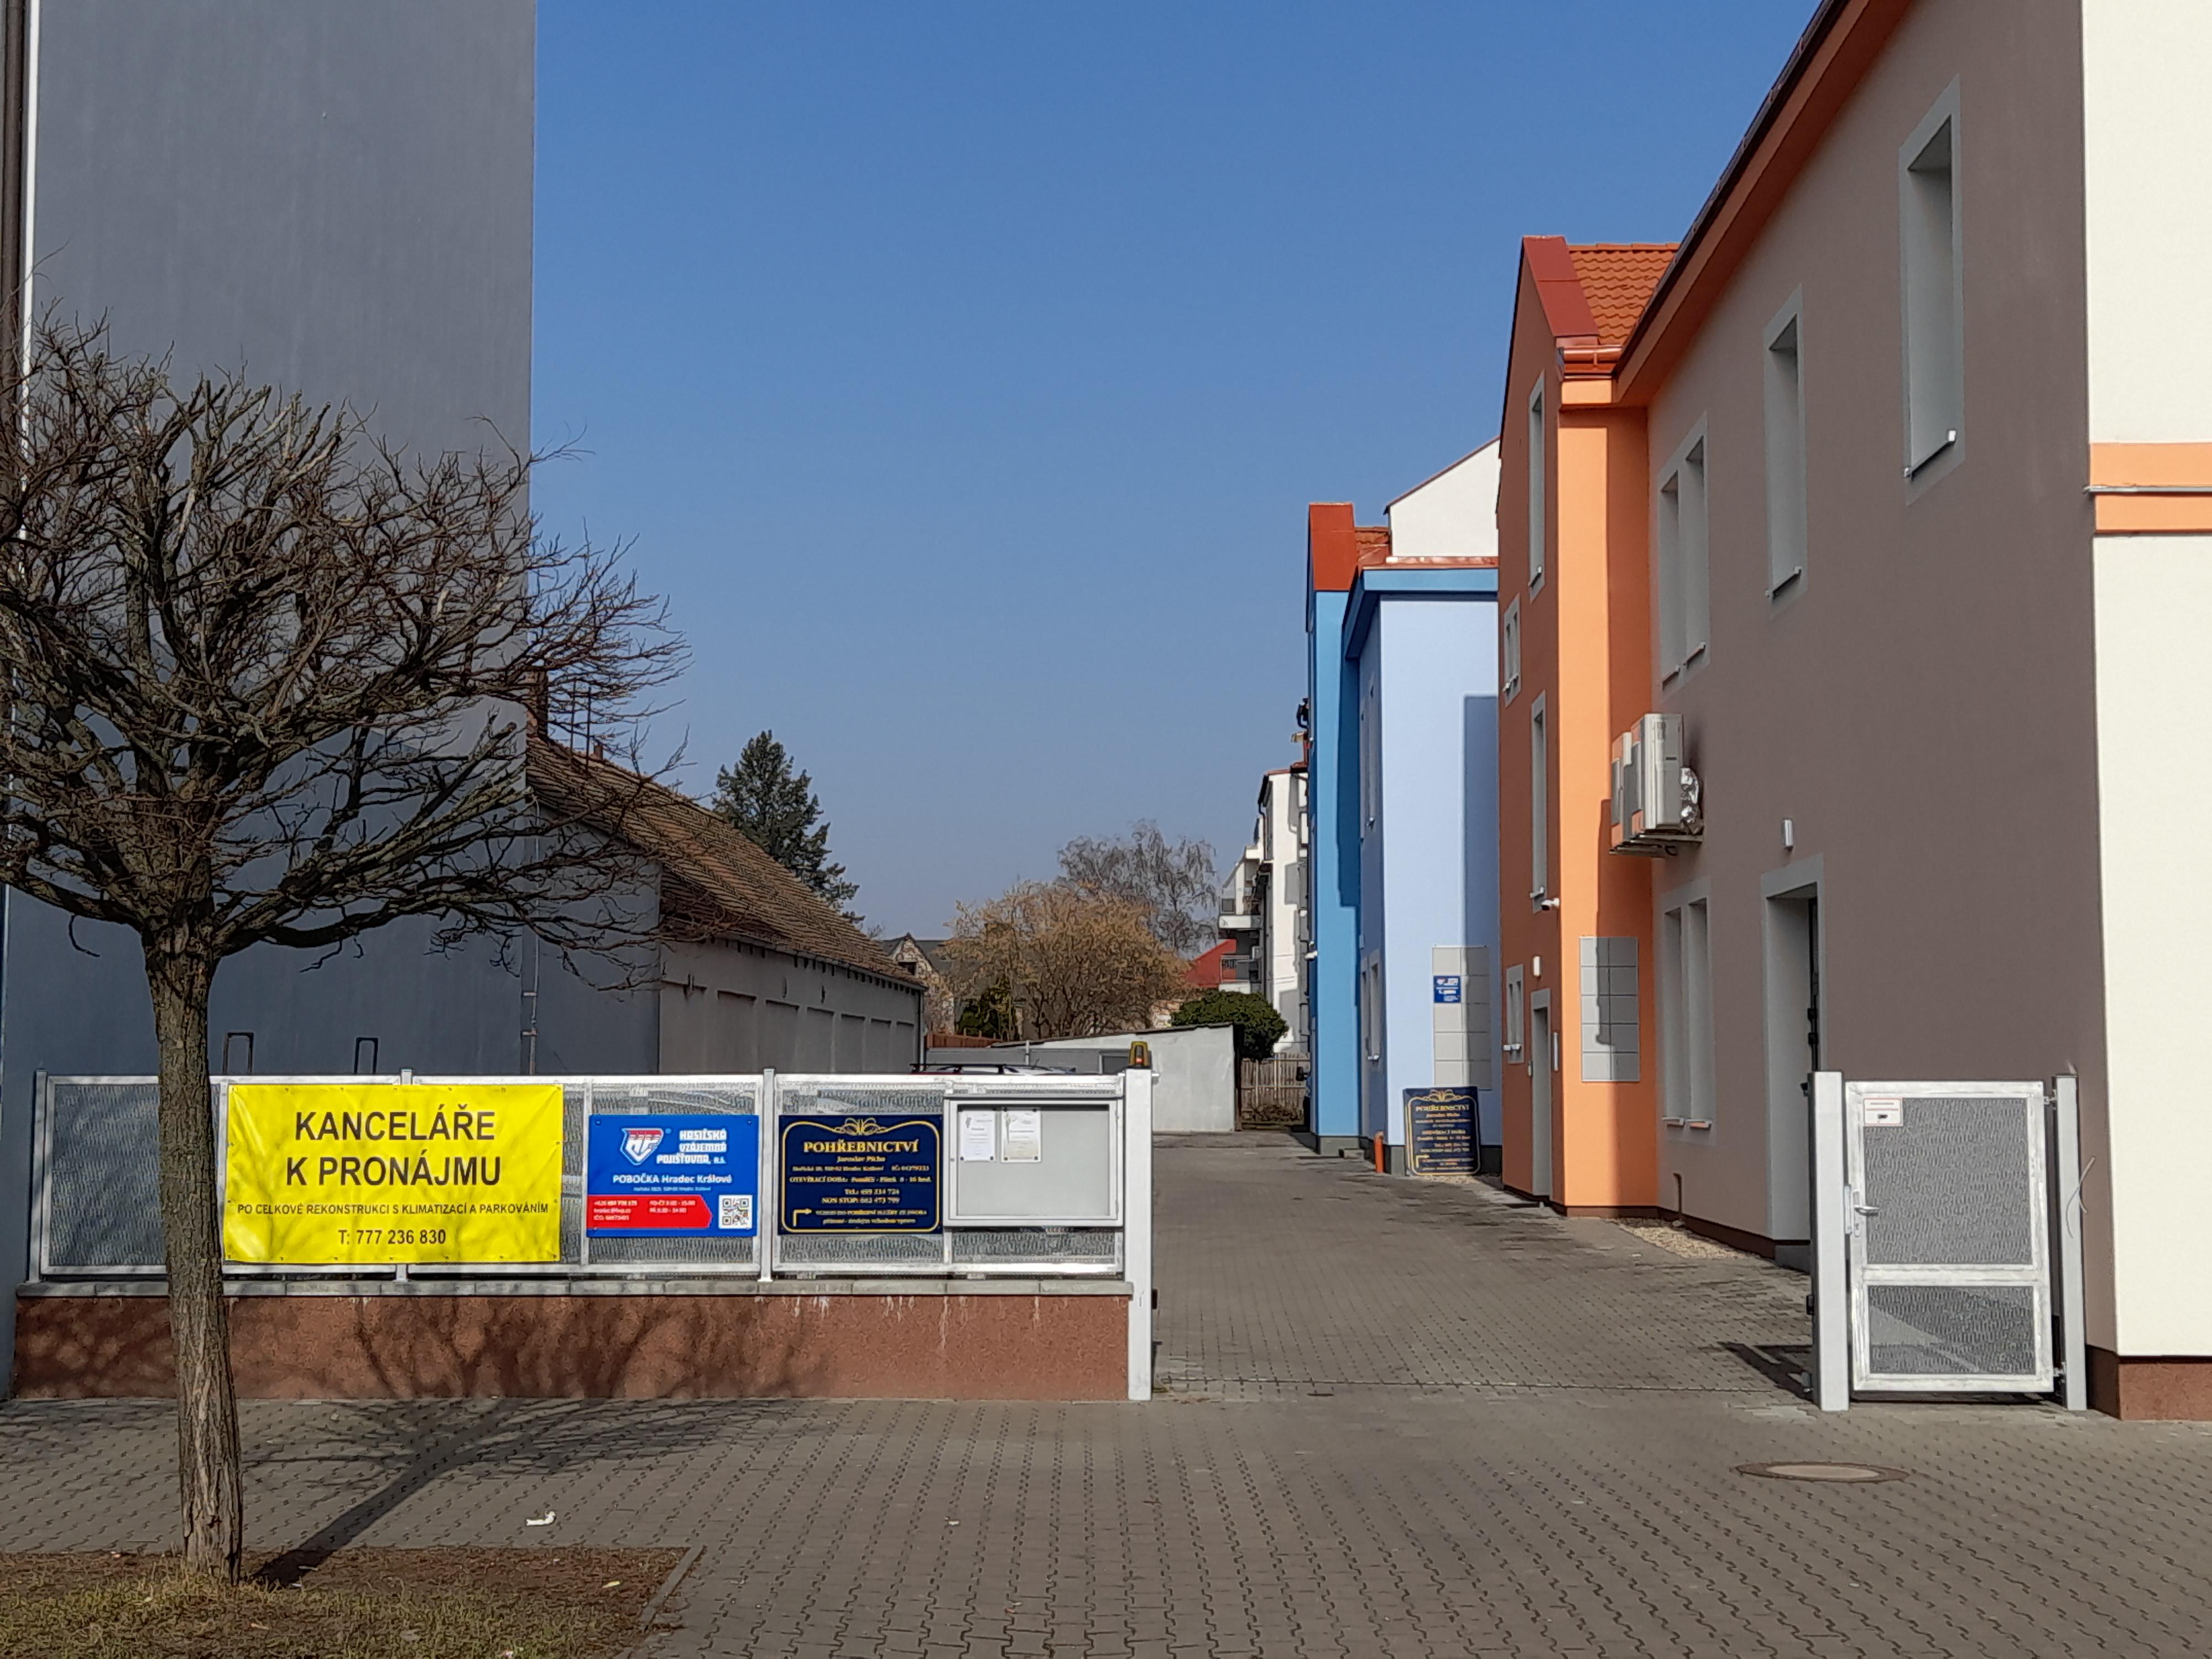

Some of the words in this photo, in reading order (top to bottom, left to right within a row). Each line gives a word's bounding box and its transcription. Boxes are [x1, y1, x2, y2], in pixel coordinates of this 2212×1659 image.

[295, 1104, 495, 1140] KANCELÁŘE
[804, 1139, 919, 1152] POHŘEBNICTVÍ
[286, 1157, 307, 1186] K
[319, 1150, 501, 1186] PRONÁJMU
[613, 1173, 659, 1183] POBOČKA
[661, 1175, 695, 1183] Hradec
[697, 1173, 732, 1183] Králové
[237, 1204, 252, 1214] PO
[255, 1203, 304, 1214] CELKOVÉ
[306, 1204, 389, 1214] REKONSTRUKCI
[393, 1204, 399, 1214] S
[402, 1202, 467, 1214] KLIMATIZACÍ
[469, 1204, 477, 1213] A
[479, 1201, 549, 1213] PARKOVÁNÍM
[338, 1230, 351, 1244] T:
[356, 1230, 382, 1244] 777
[388, 1230, 414, 1244] 236
[419, 1229, 446, 1244] 830
